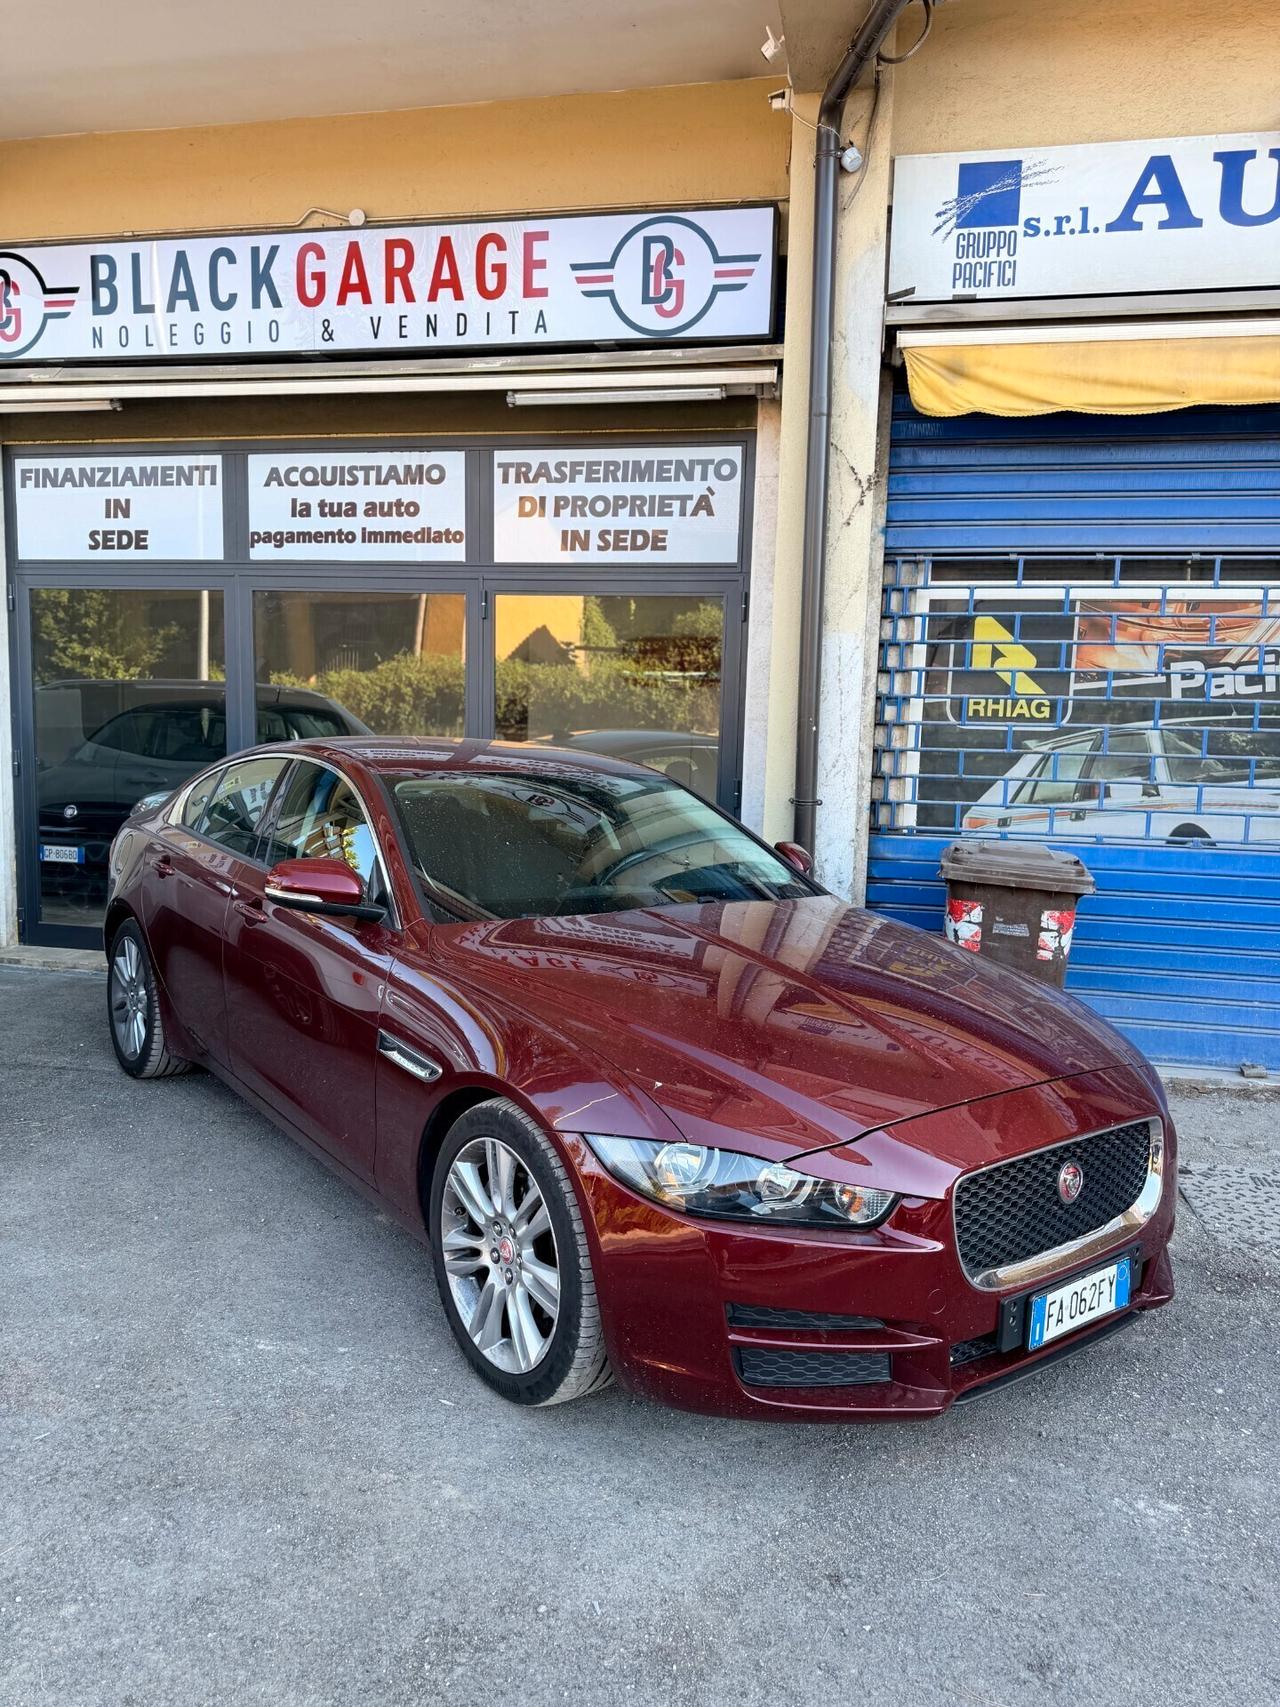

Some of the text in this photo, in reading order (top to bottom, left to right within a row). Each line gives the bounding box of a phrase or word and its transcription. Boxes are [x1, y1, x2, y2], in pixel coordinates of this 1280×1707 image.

[1105, 148, 1280, 232] AU
[956, 230, 1017, 259] GRUPPO
[952, 260, 1017, 289] PACIFICI
[92, 309, 548, 349] NOLEGGIO & VENDITA
[20, 464, 217, 489] FINANZIAMENTI
[264, 464, 446, 488] ACQUISTIAMO
[497, 458, 738, 484] TRASFERIMENTO
[104, 498, 131, 519] IN
[291, 498, 420, 518] la tua auto
[518, 486, 716, 518] DI PROPRIETÀ
[88, 529, 149, 550] SEDE
[250, 527, 465, 549] pagamento immediato
[560, 529, 668, 552] IN SEDE
[1170, 652, 1280, 698] Paci
[967, 698, 1052, 719] RHIAG
